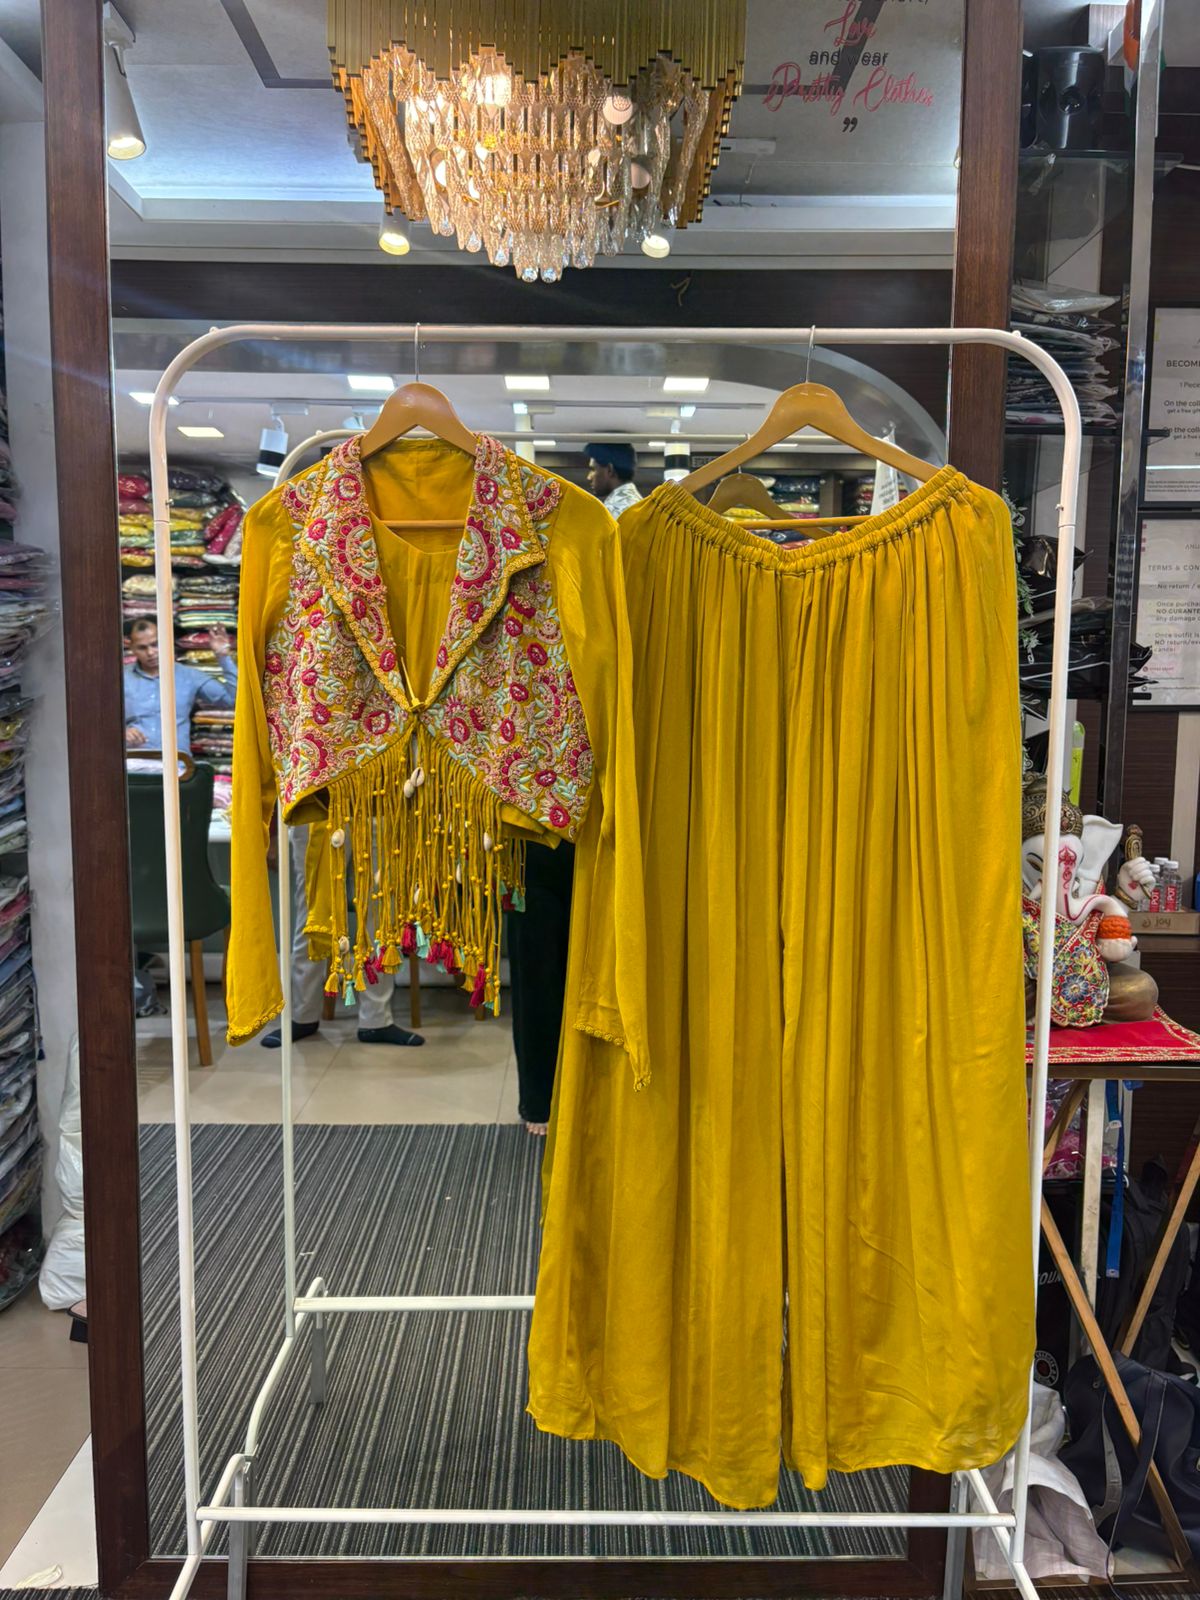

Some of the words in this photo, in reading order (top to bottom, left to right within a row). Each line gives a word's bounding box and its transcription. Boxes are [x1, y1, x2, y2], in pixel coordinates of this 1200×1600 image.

[808, 48, 841, 66] and
[848, 51, 889, 67] wear
[762, 61, 846, 117] Pretty
